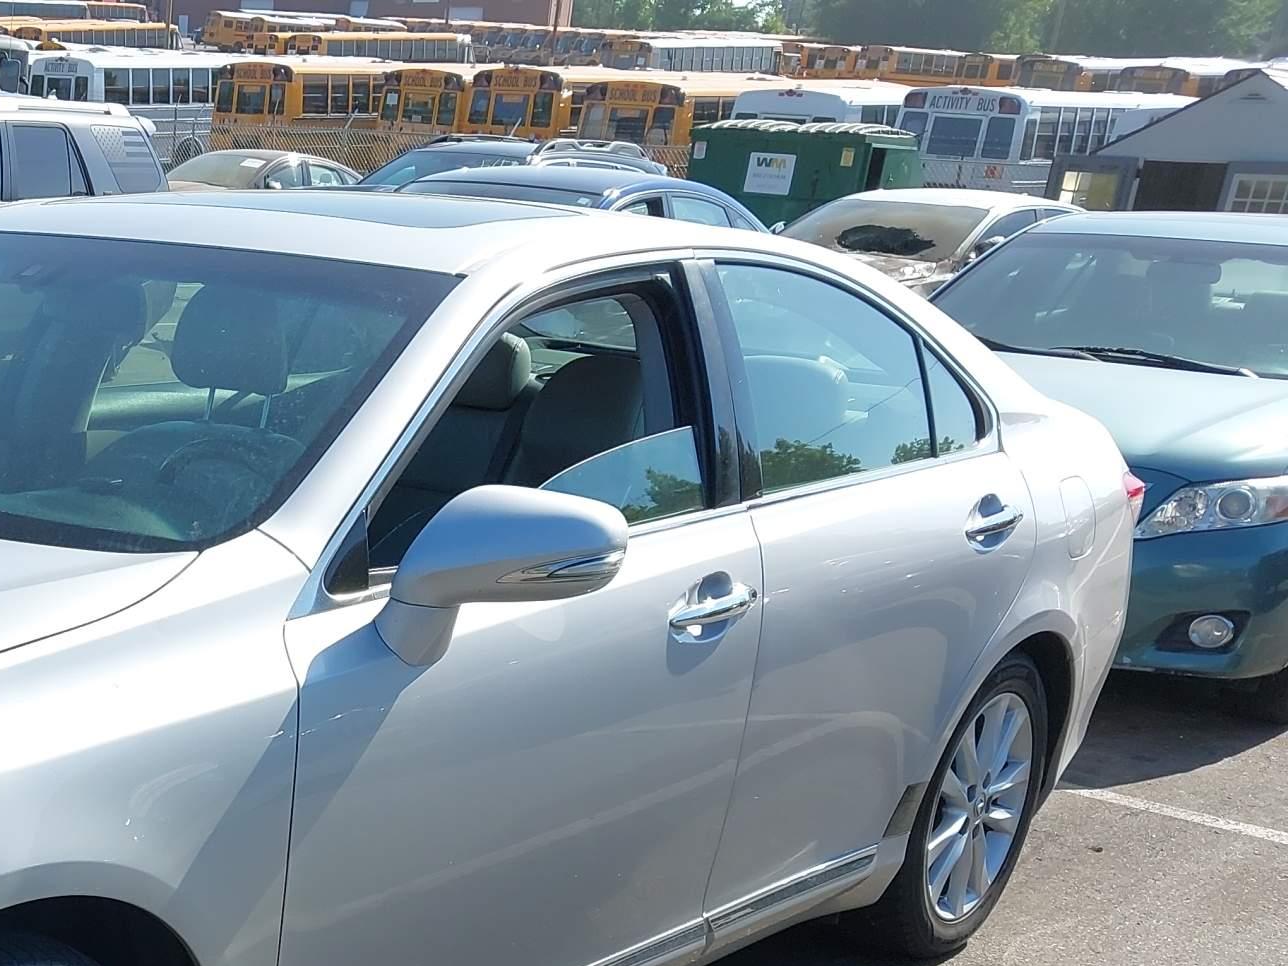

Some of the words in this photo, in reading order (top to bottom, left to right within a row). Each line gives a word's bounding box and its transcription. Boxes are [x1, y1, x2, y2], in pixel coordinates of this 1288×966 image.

[236, 68, 257, 80] SCHOOL
[404, 75, 426, 87] SCHOOL
[430, 76, 442, 88] BUS
[494, 75, 519, 87] SCHOOL
[523, 76, 537, 88] BUS
[609, 87, 637, 101] SCHOOL
[641, 88, 657, 103] BUS
[929, 95, 972, 110] ACTIVITY
[976, 96, 997, 112] BUS
[757, 156, 786, 168] WM
